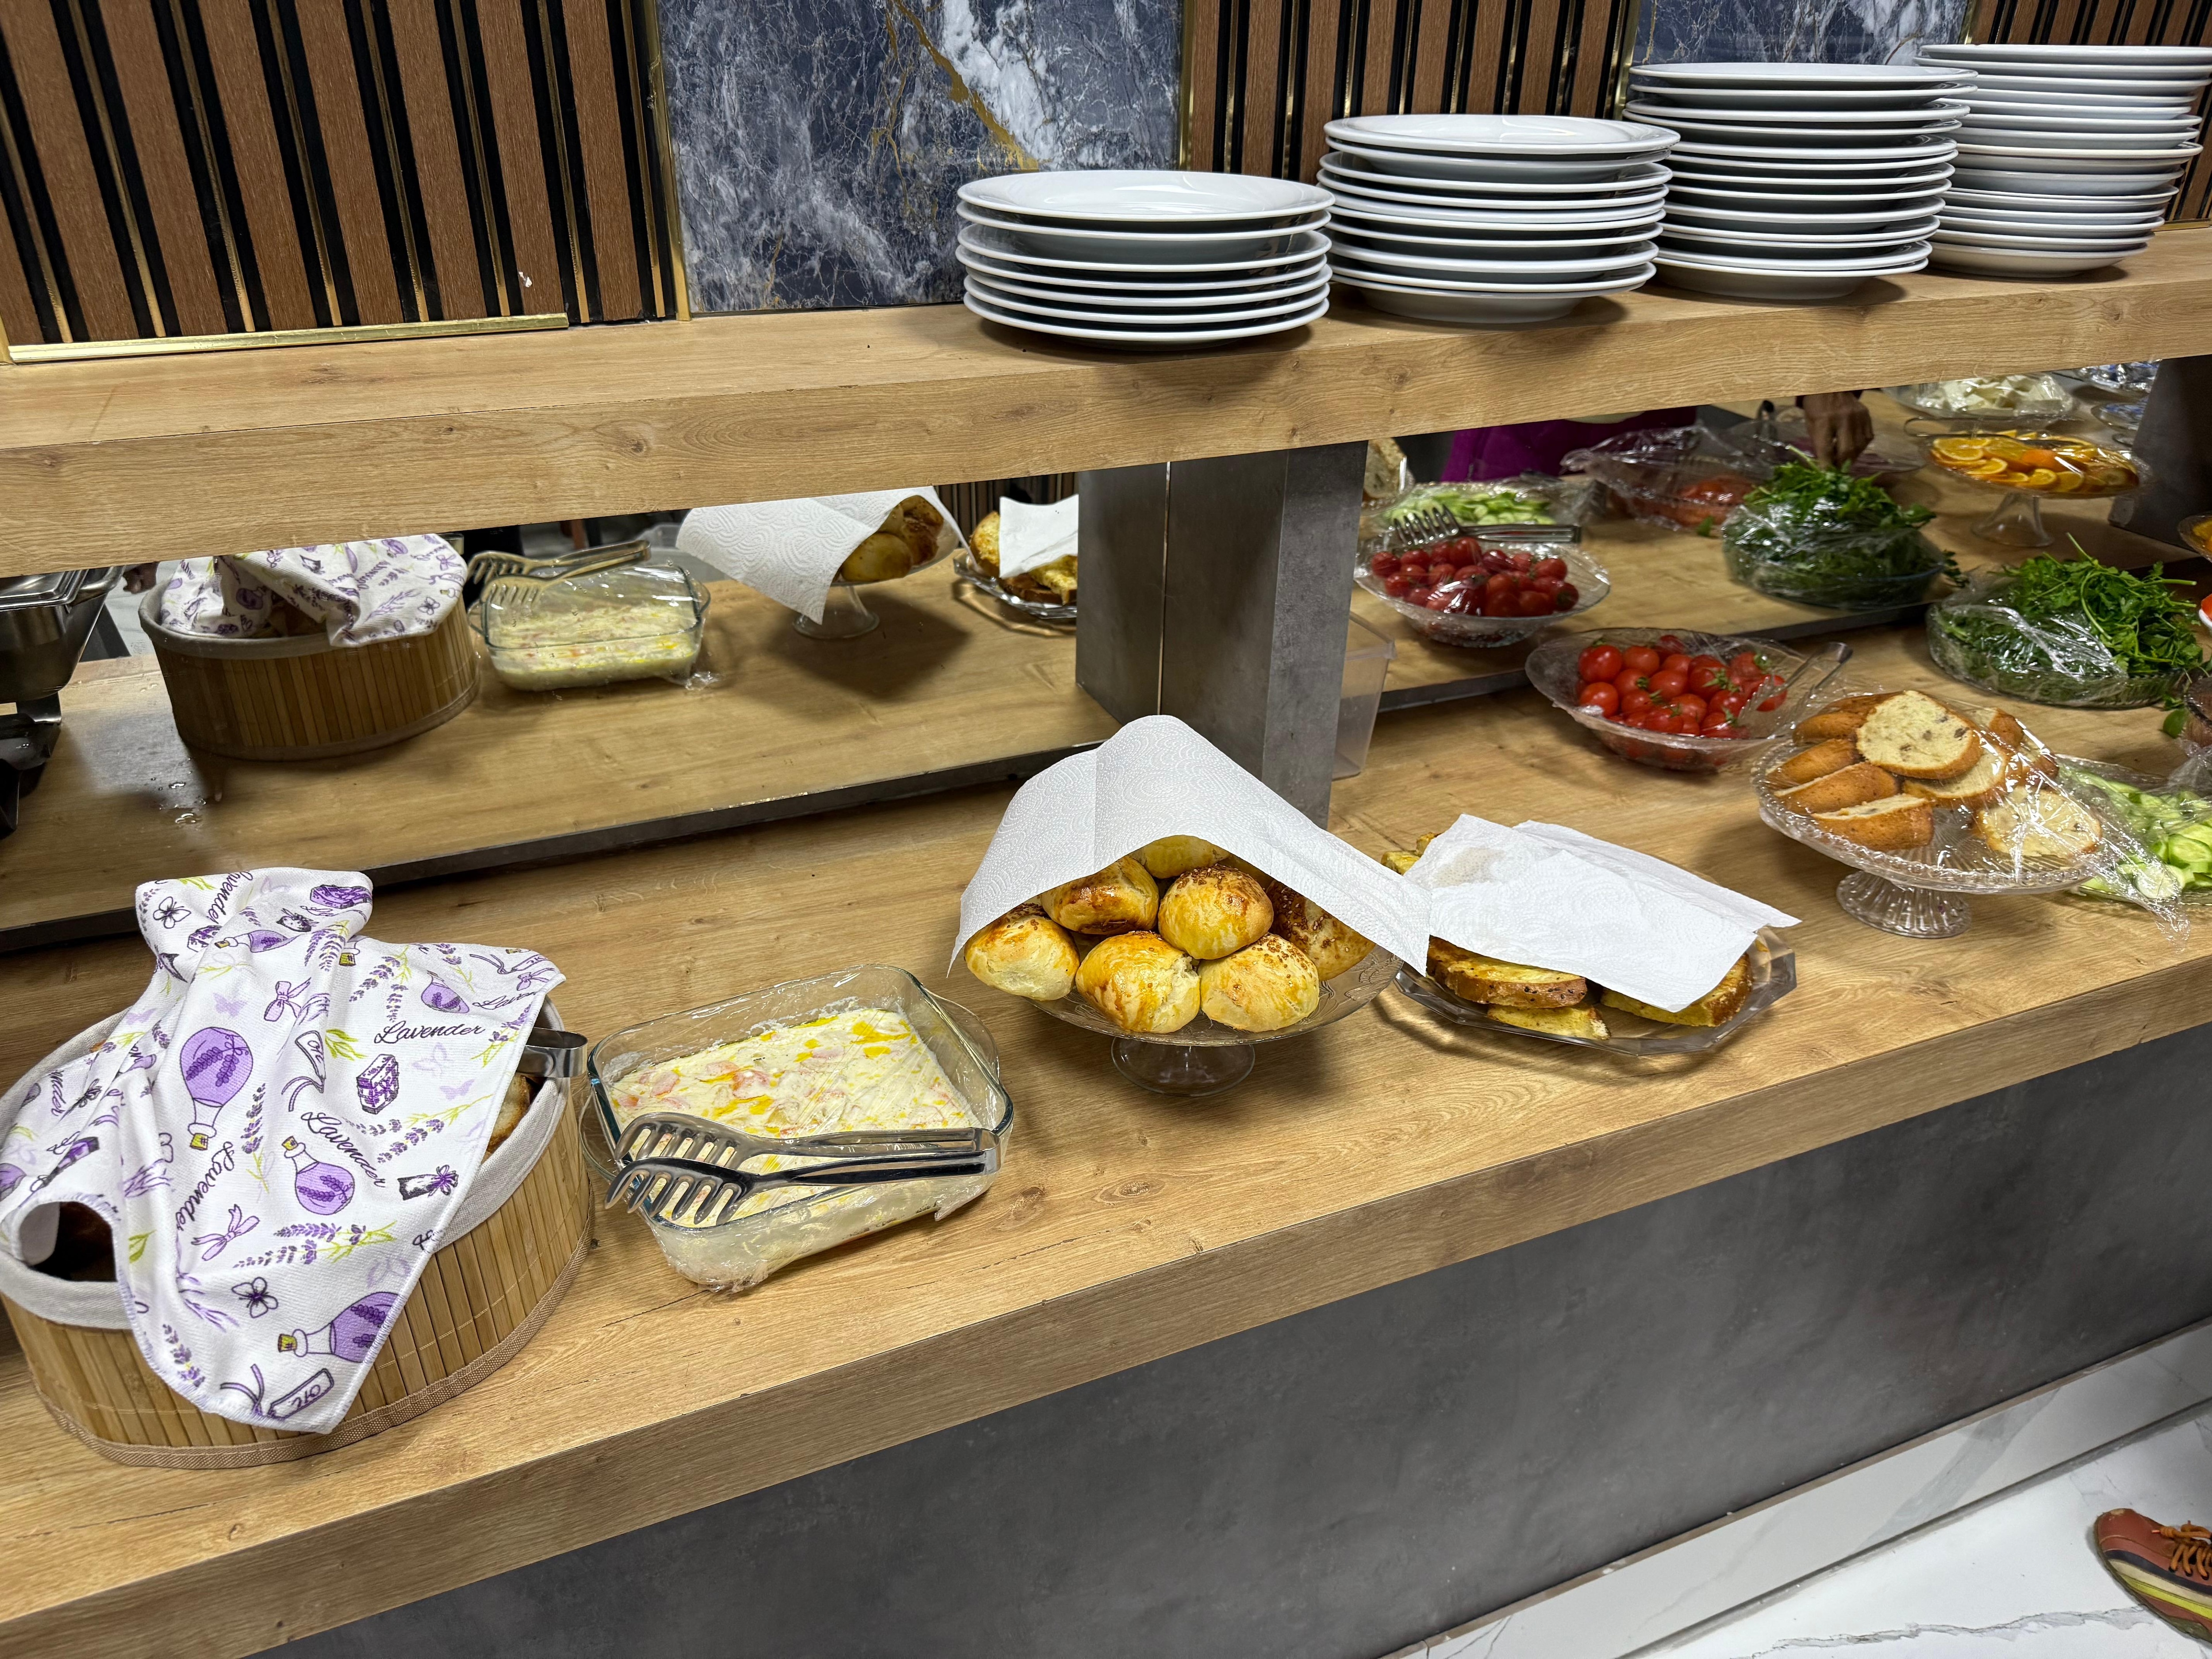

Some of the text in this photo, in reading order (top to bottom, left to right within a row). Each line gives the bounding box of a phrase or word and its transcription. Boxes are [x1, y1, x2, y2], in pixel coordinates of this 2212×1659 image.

[374, 1020, 486, 1044] Lavender
[175, 1141, 234, 1231] Lavender
[300, 1112, 386, 1187] Lavender
